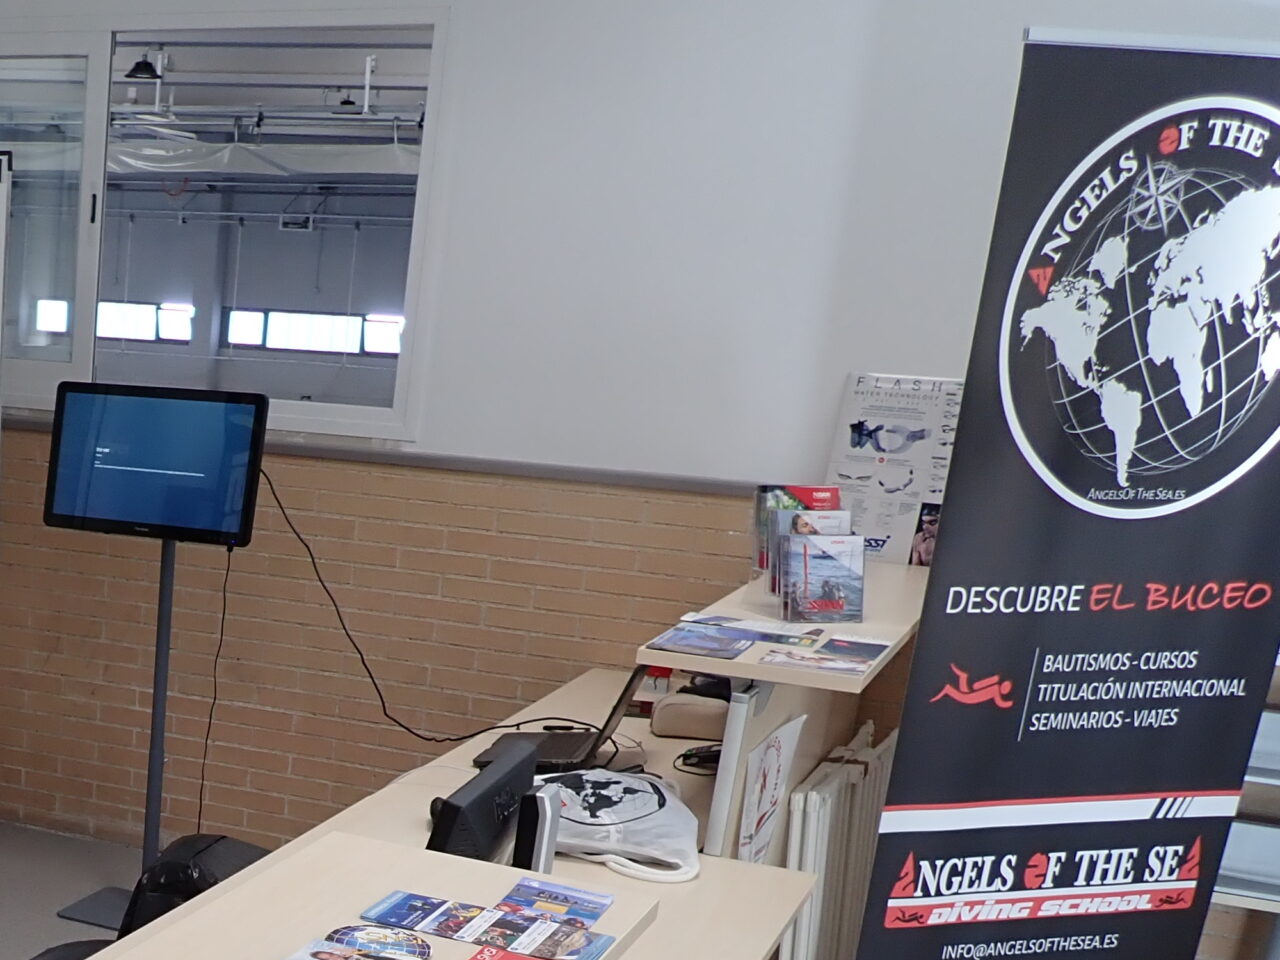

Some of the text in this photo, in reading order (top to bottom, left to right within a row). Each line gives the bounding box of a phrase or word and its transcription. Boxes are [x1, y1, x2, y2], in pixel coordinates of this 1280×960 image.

[1028, 119, 1270, 296] ANGELS OF THE
[945, 581, 1272, 614] DESCUBRE EL BUCEO
[1043, 652, 1131, 672] BAUTISMOS
[1140, 651, 1198, 670] CURSOS
[1038, 678, 1247, 702] TITULACIÓN INTERNACIONAL
[1030, 711, 1124, 731] SEMINARIOS
[1133, 708, 1179, 729] VIAJES
[889, 835, 1202, 898] ANGELS OF THE SEA
[941, 933, 1119, 960] INFO@ANGELSOFTHESEA.ES
